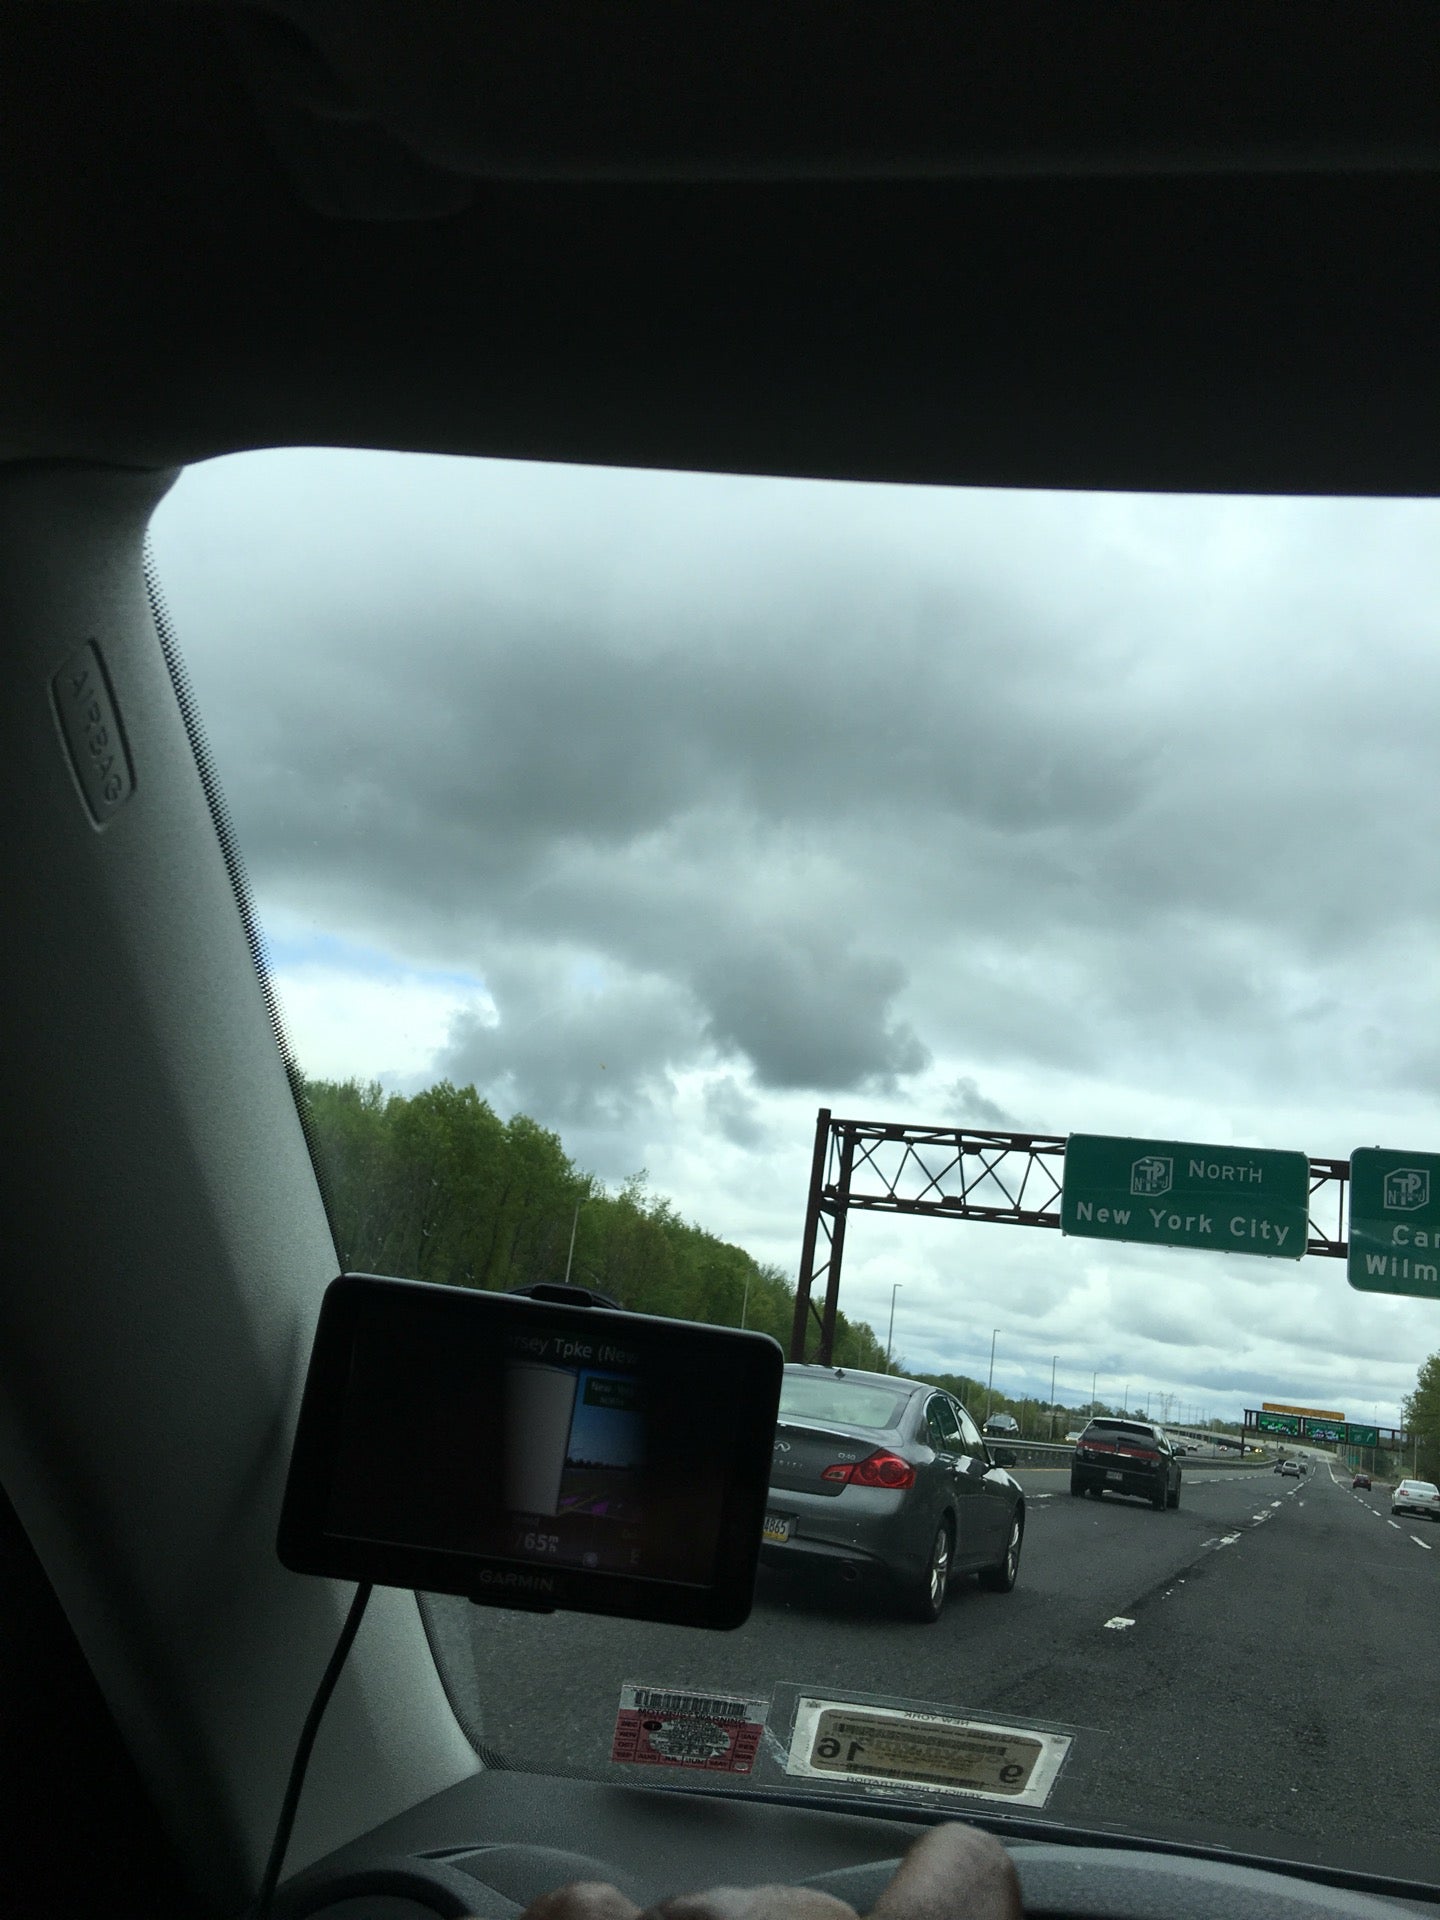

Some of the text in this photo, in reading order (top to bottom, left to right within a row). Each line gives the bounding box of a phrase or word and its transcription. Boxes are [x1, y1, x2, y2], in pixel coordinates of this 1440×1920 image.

[1076, 1202, 1289, 1246] New York City
[554, 1338, 592, 1358] Tpke
[480, 1568, 555, 1592] GARMIN
